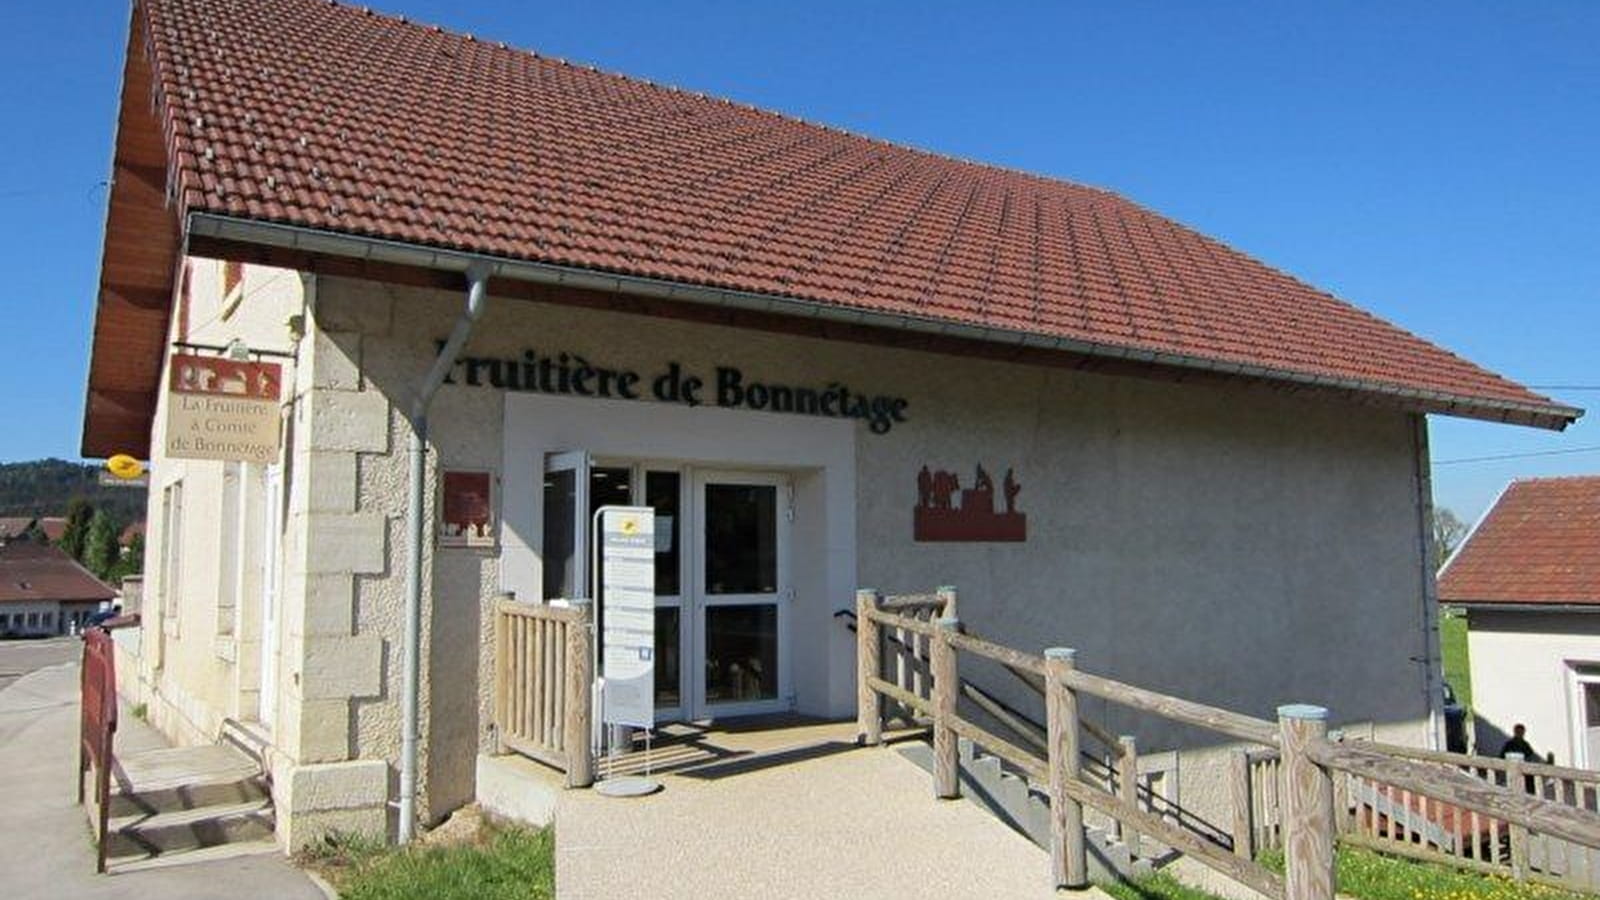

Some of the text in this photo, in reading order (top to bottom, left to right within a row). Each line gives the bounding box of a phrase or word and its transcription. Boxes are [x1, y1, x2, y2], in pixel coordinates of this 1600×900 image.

[653, 361, 703, 407] de
[715, 366, 909, 435] Bonnétage
[171, 435, 191, 451] de
